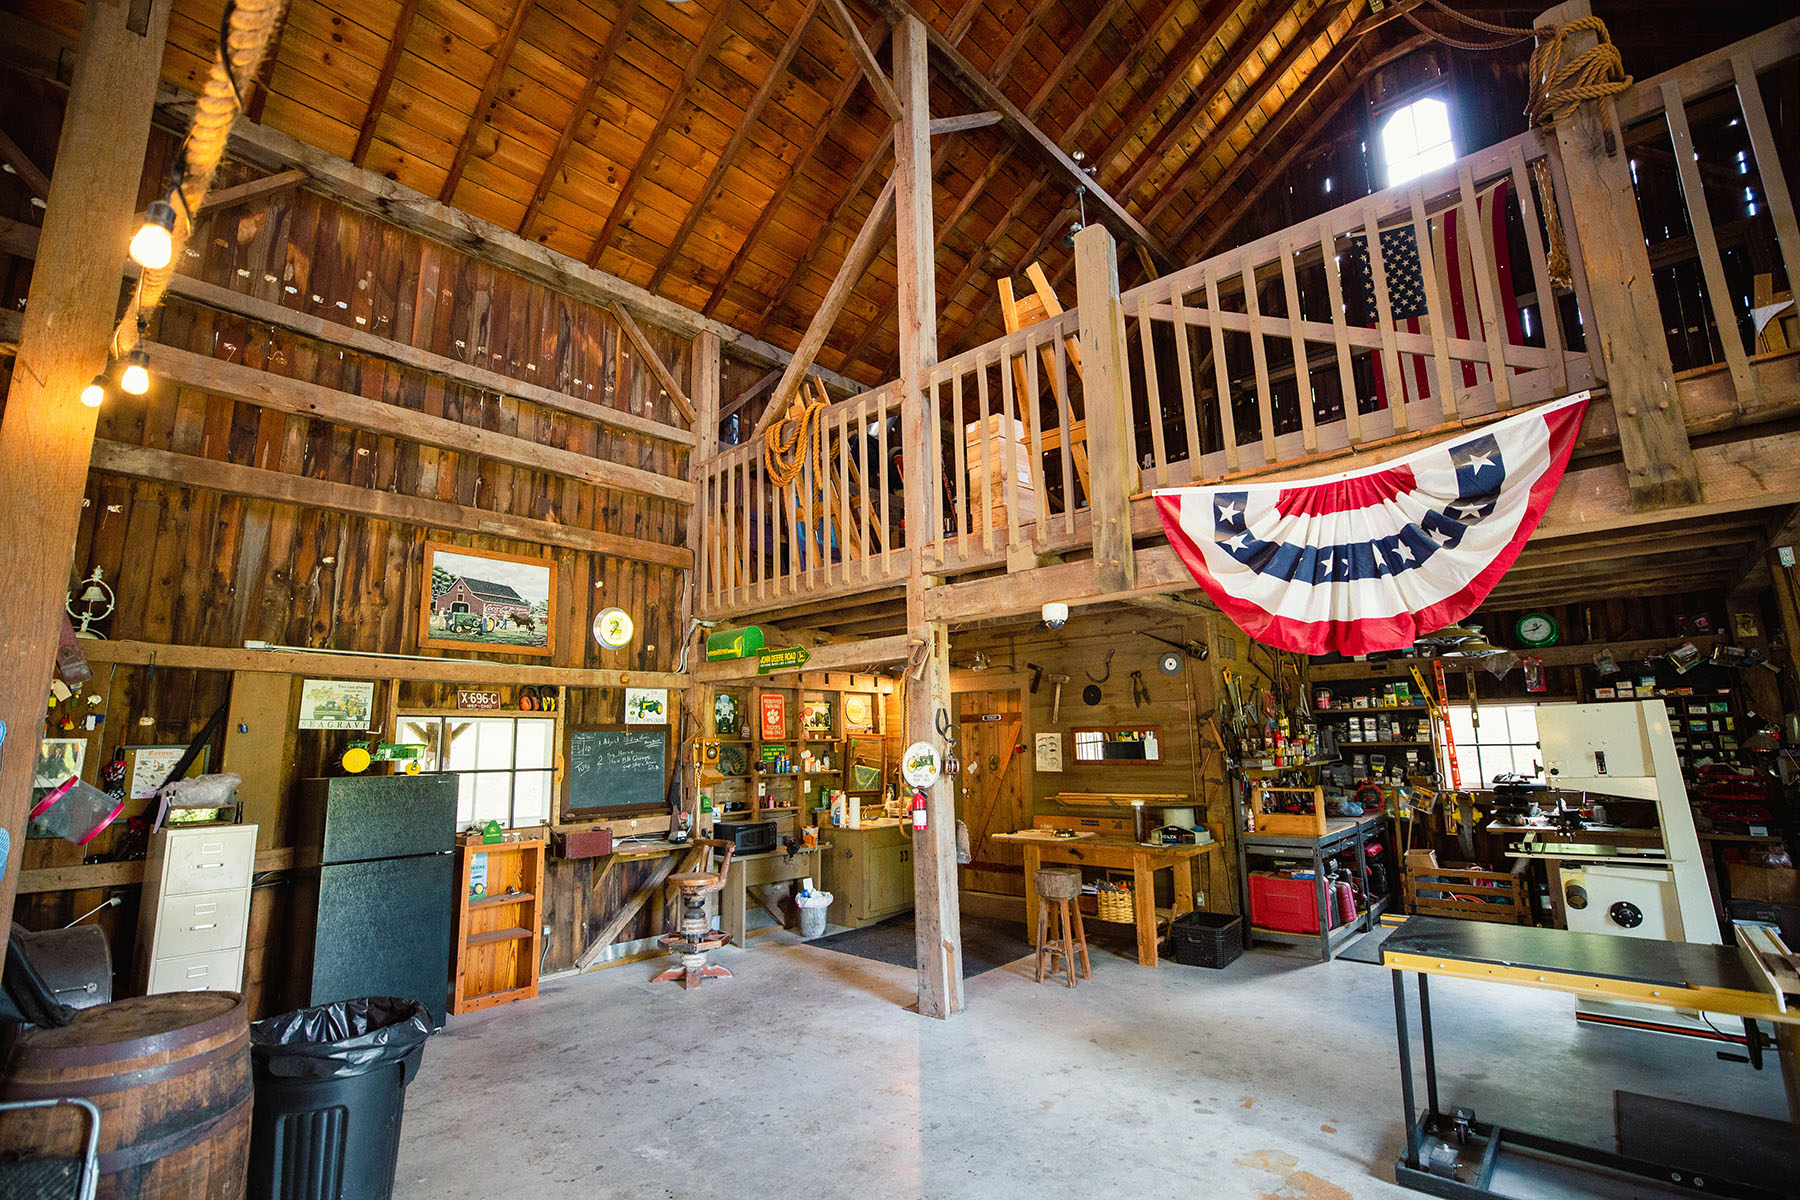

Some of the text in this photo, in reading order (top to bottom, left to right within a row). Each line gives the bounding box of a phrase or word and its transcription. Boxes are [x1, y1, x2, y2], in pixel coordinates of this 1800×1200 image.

[760, 652, 797, 664] JOHN DEERE ROAD
[301, 721, 369, 729] SEAGRAVE
